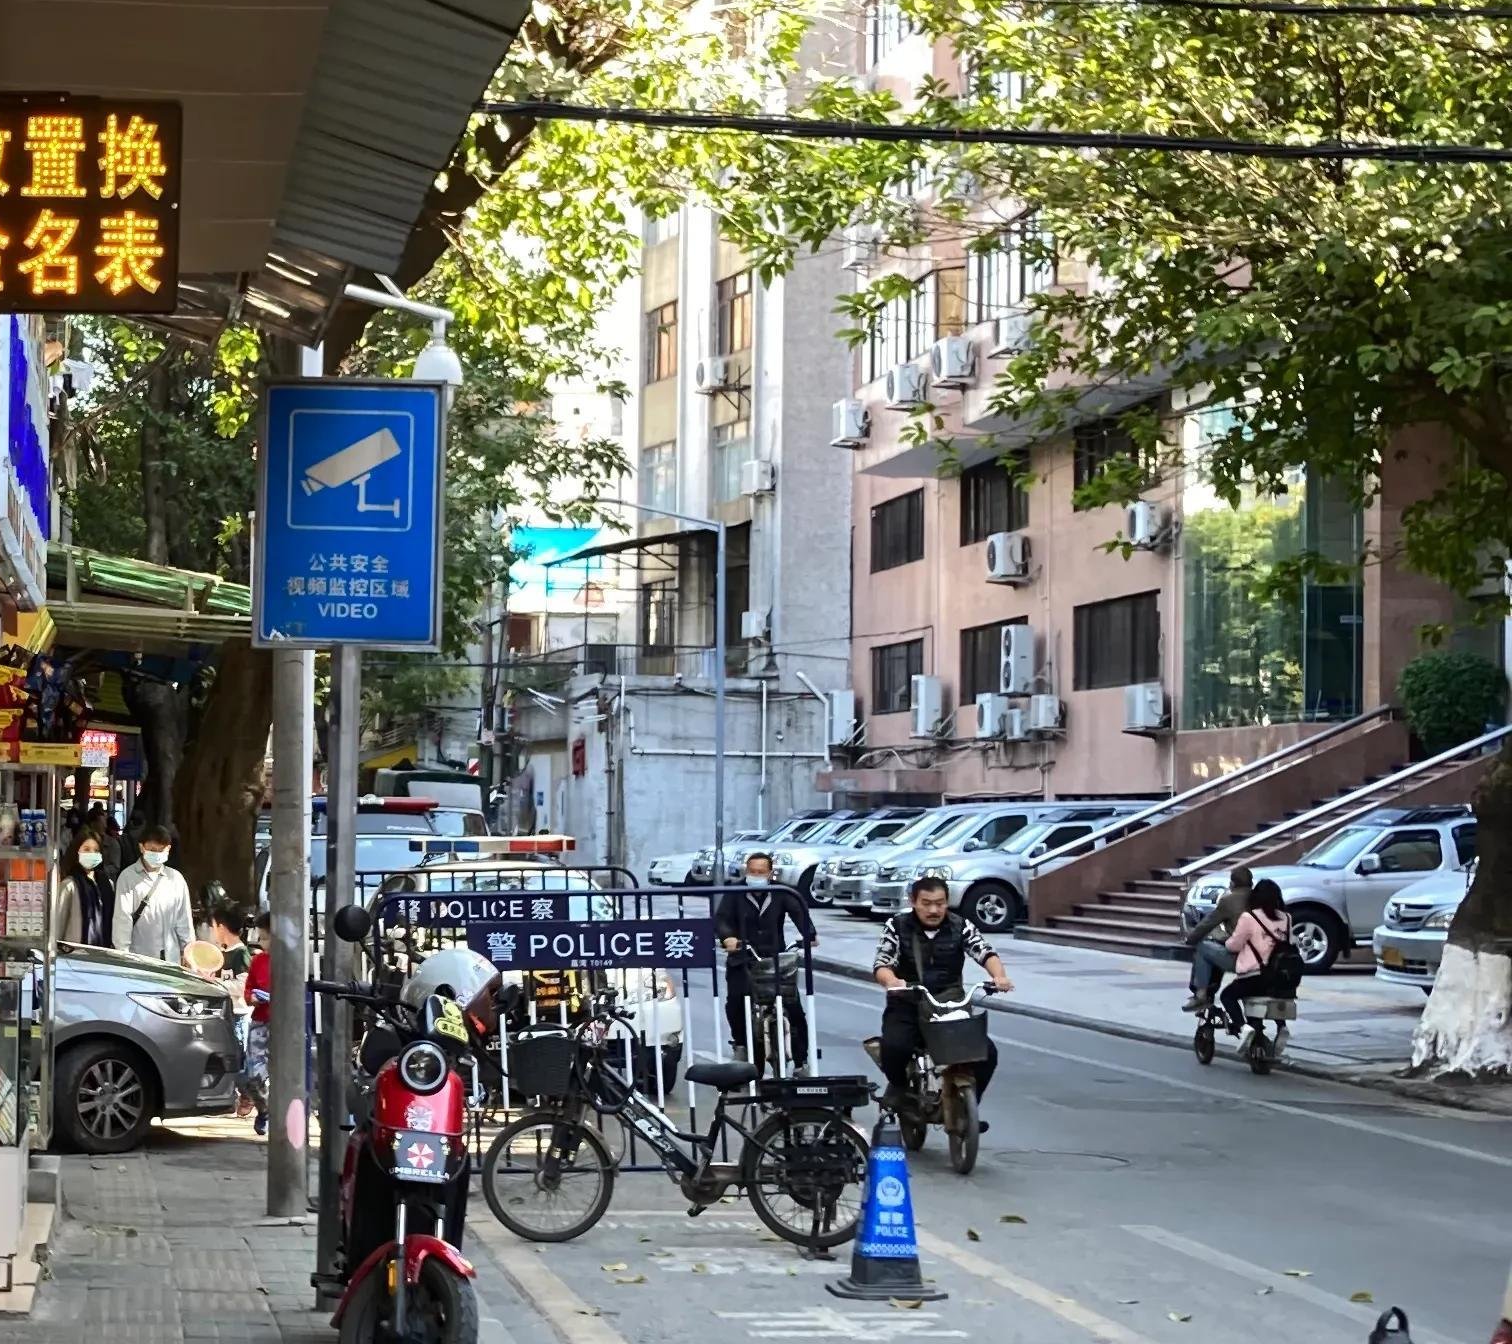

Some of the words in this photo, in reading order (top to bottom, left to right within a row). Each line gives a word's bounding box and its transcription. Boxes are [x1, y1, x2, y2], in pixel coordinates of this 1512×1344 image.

[308, 553, 389, 574] 公共安全
[287, 576, 410, 598] 视频监控区域
[318, 602, 378, 619] VIDEO
[531, 898, 555, 921] 察
[487, 932, 517, 962] 警
[530, 932, 655, 958] POLICE
[664, 929, 695, 959] 察
[875, 1225, 909, 1238] POLICE
